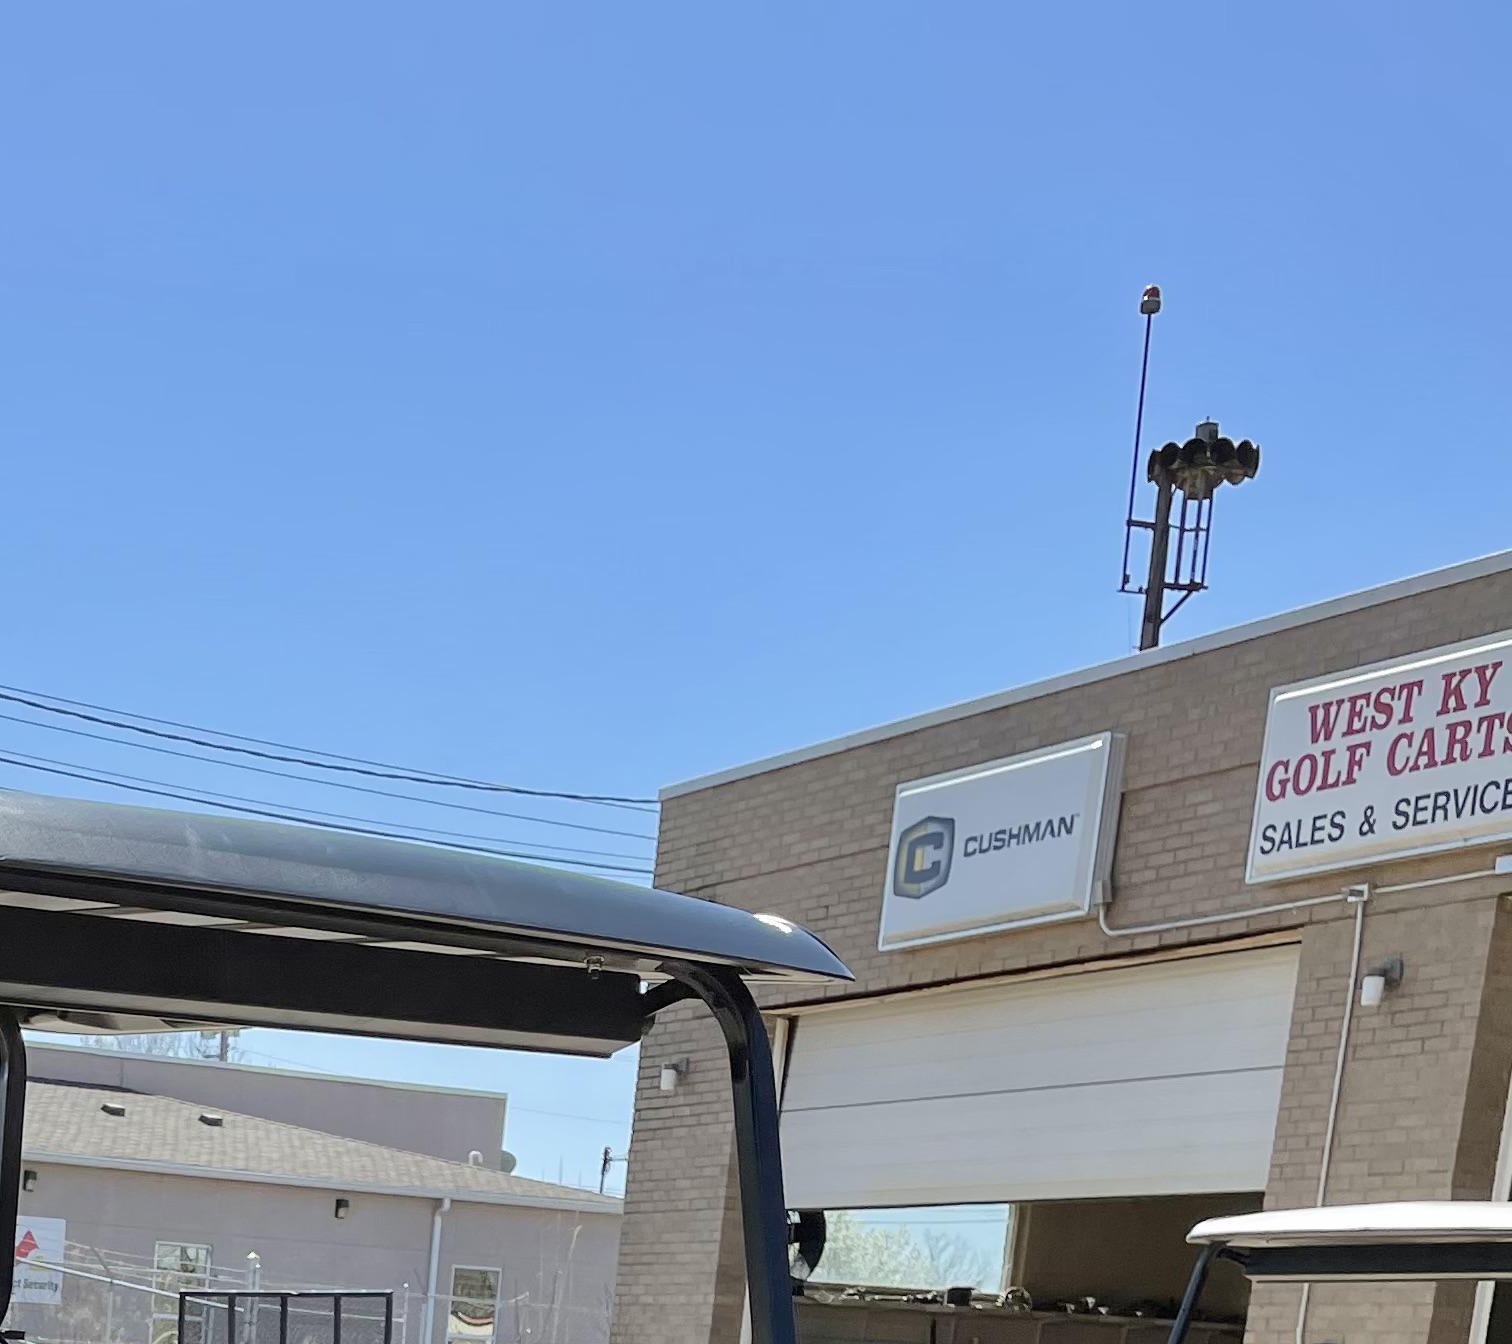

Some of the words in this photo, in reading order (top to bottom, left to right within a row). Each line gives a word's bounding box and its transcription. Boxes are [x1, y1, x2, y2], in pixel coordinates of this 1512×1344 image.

[1308, 679, 1424, 744] WEST
[1436, 660, 1503, 717] KY
[1265, 740, 1372, 802] GOLF
[963, 814, 1075, 857] CUSHMAN
[1260, 810, 1346, 855] SALES
[1359, 805, 1377, 836] &
